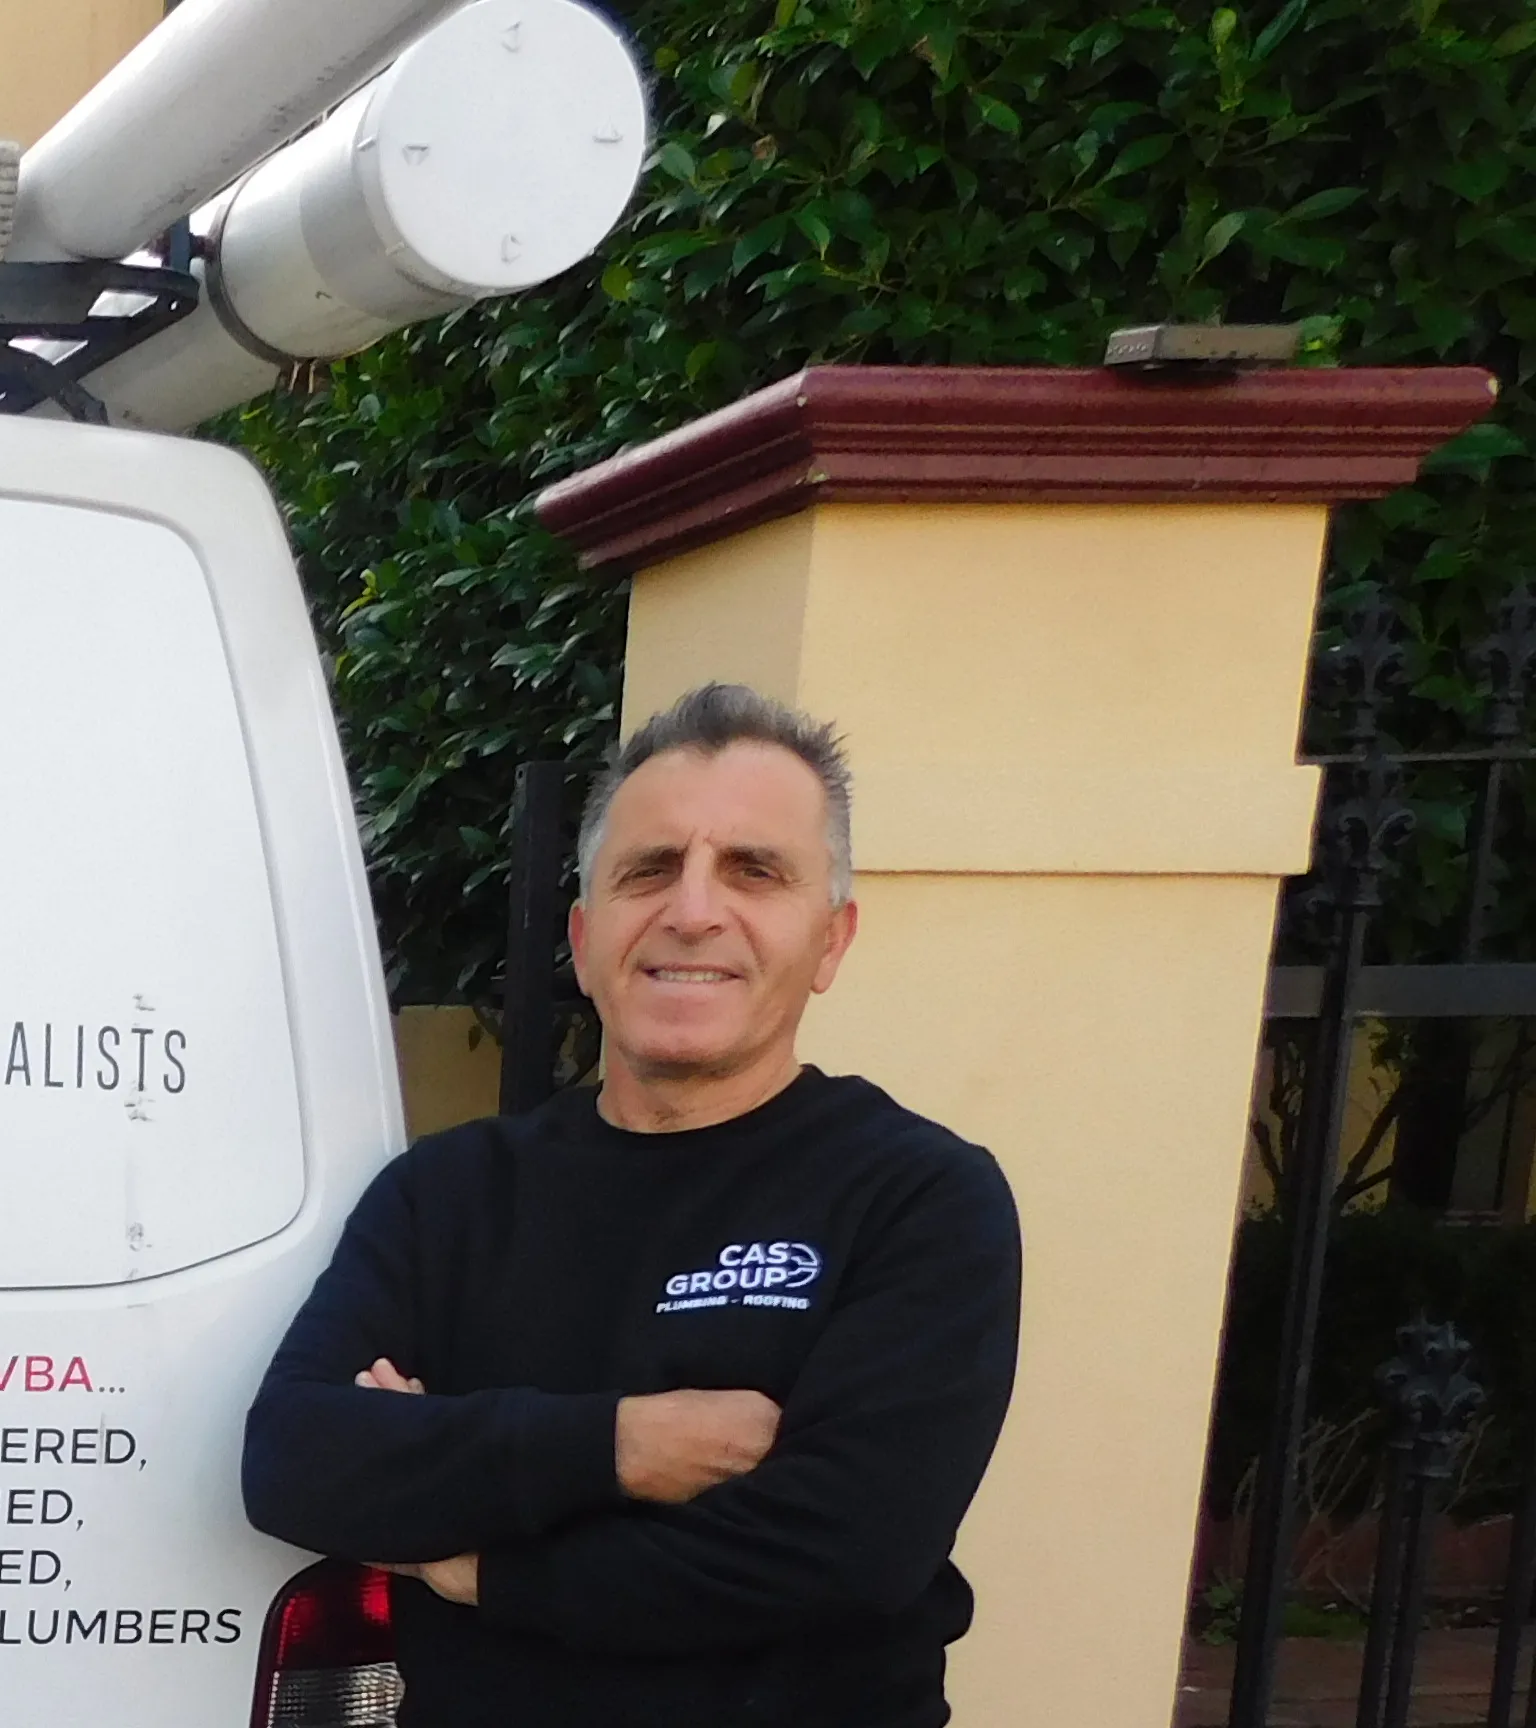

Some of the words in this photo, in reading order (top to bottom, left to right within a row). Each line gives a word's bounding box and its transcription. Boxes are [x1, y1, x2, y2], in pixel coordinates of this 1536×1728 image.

[719, 1242, 789, 1266] CAS
[666, 1267, 788, 1295] GROUP
[742, 1294, 812, 1310] ROOFING
